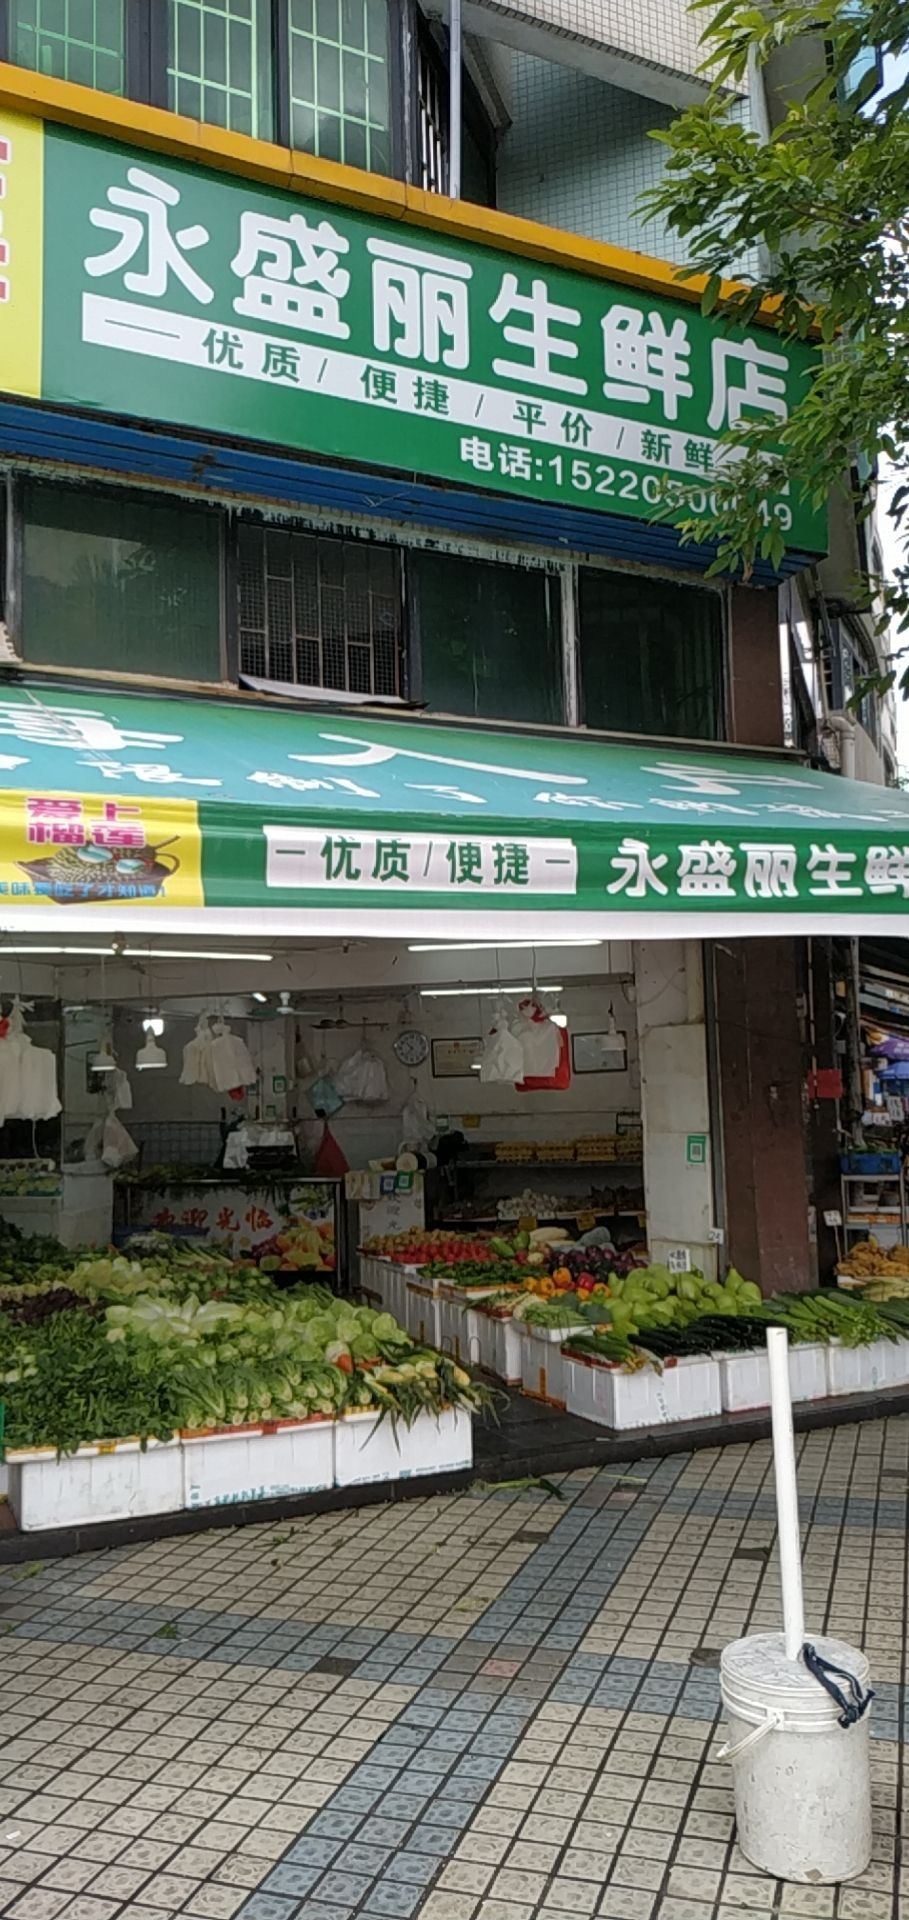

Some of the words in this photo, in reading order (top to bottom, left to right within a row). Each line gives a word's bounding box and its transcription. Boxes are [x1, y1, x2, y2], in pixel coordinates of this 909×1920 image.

[84, 167, 789, 431] 永盛丽生鲜店
[27, 798, 141, 820] 爱上
[28, 821, 146, 847] 榴莲
[607, 838, 909, 899] 永盛丽生鲜
